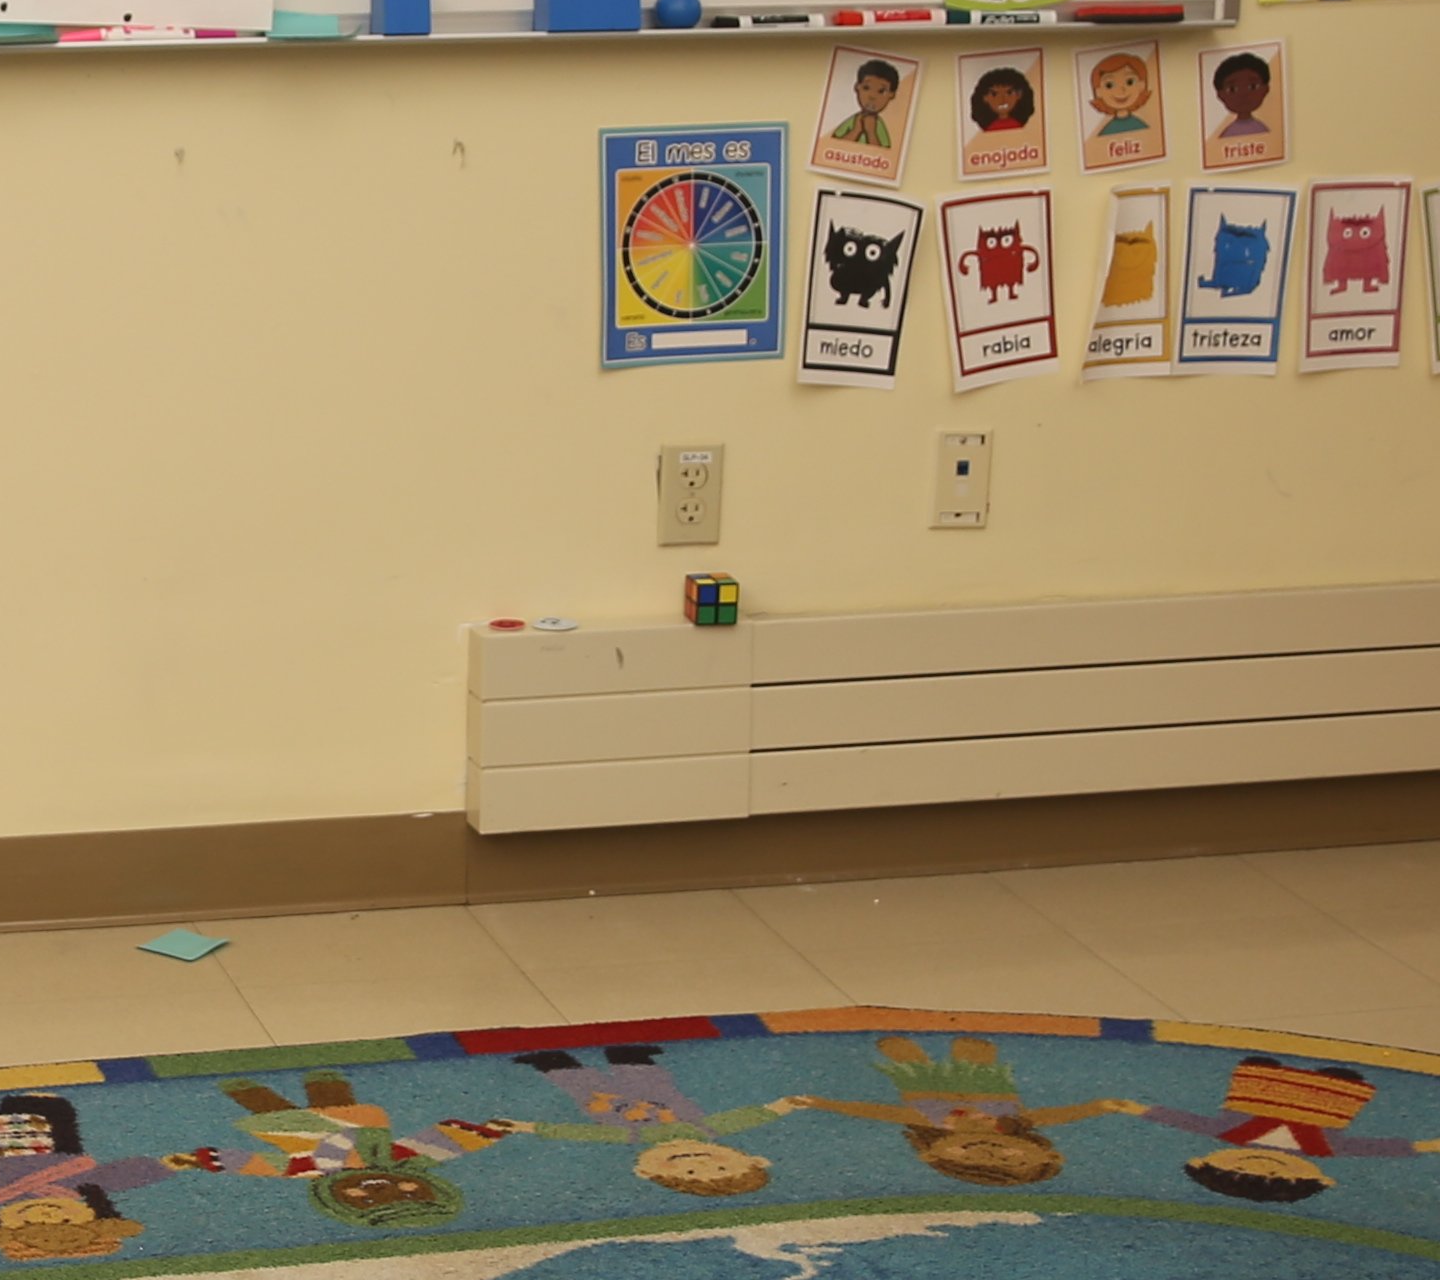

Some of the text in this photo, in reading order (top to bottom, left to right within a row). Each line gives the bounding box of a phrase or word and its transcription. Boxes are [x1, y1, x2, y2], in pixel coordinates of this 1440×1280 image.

[636, 139, 752, 166] El mes es
[824, 145, 891, 171] asustado
[969, 144, 1040, 168] enojada
[1108, 138, 1142, 159] feliz
[1222, 139, 1266, 158] triste
[980, 331, 1032, 358] rabia
[1191, 328, 1263, 349] tristeza
[1327, 324, 1378, 344] amor
[819, 336, 875, 359] miedo
